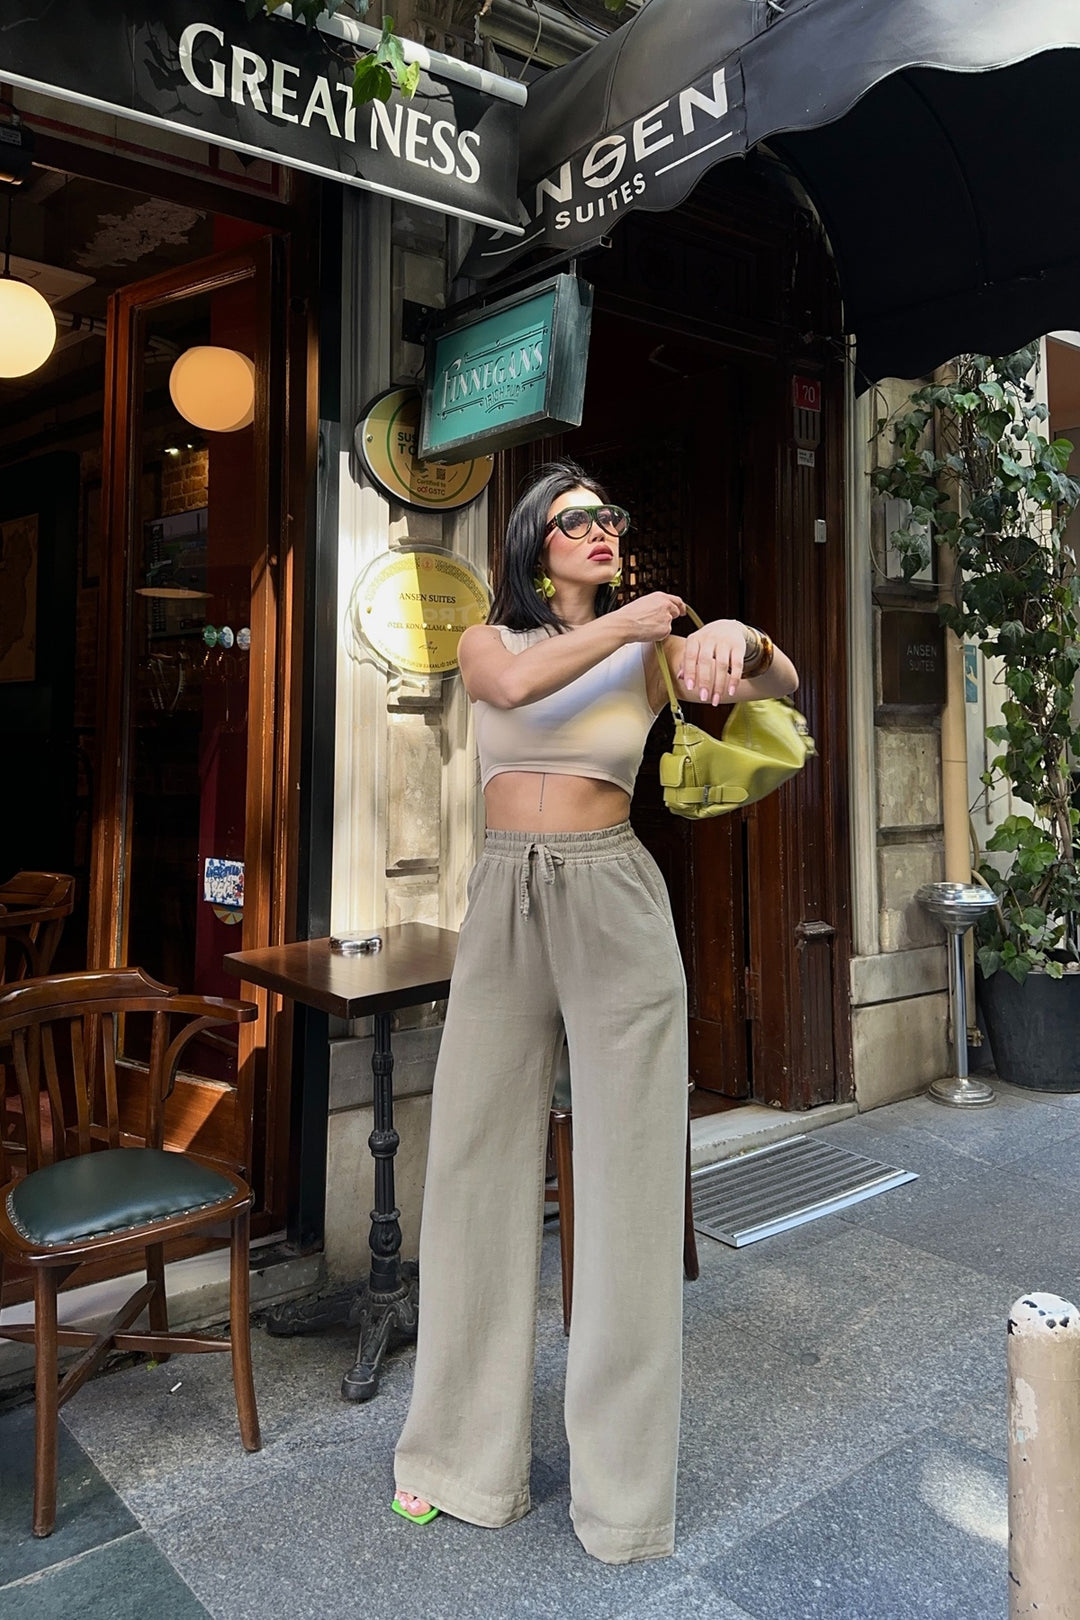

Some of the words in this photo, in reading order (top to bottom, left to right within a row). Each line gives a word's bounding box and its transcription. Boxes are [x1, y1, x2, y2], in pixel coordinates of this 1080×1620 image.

[178, 22, 482, 185] GREATNESS
[489, 67, 729, 240] NSEN
[554, 172, 647, 230] SUITES
[442, 340, 544, 410] FINNEGANS
[802, 385, 816, 403] 70
[399, 592, 427, 602] ANSEN
[428, 594, 456, 604] SUITES
[906, 644, 937, 658] ANSEN
[909, 660, 935, 673] SUITES
